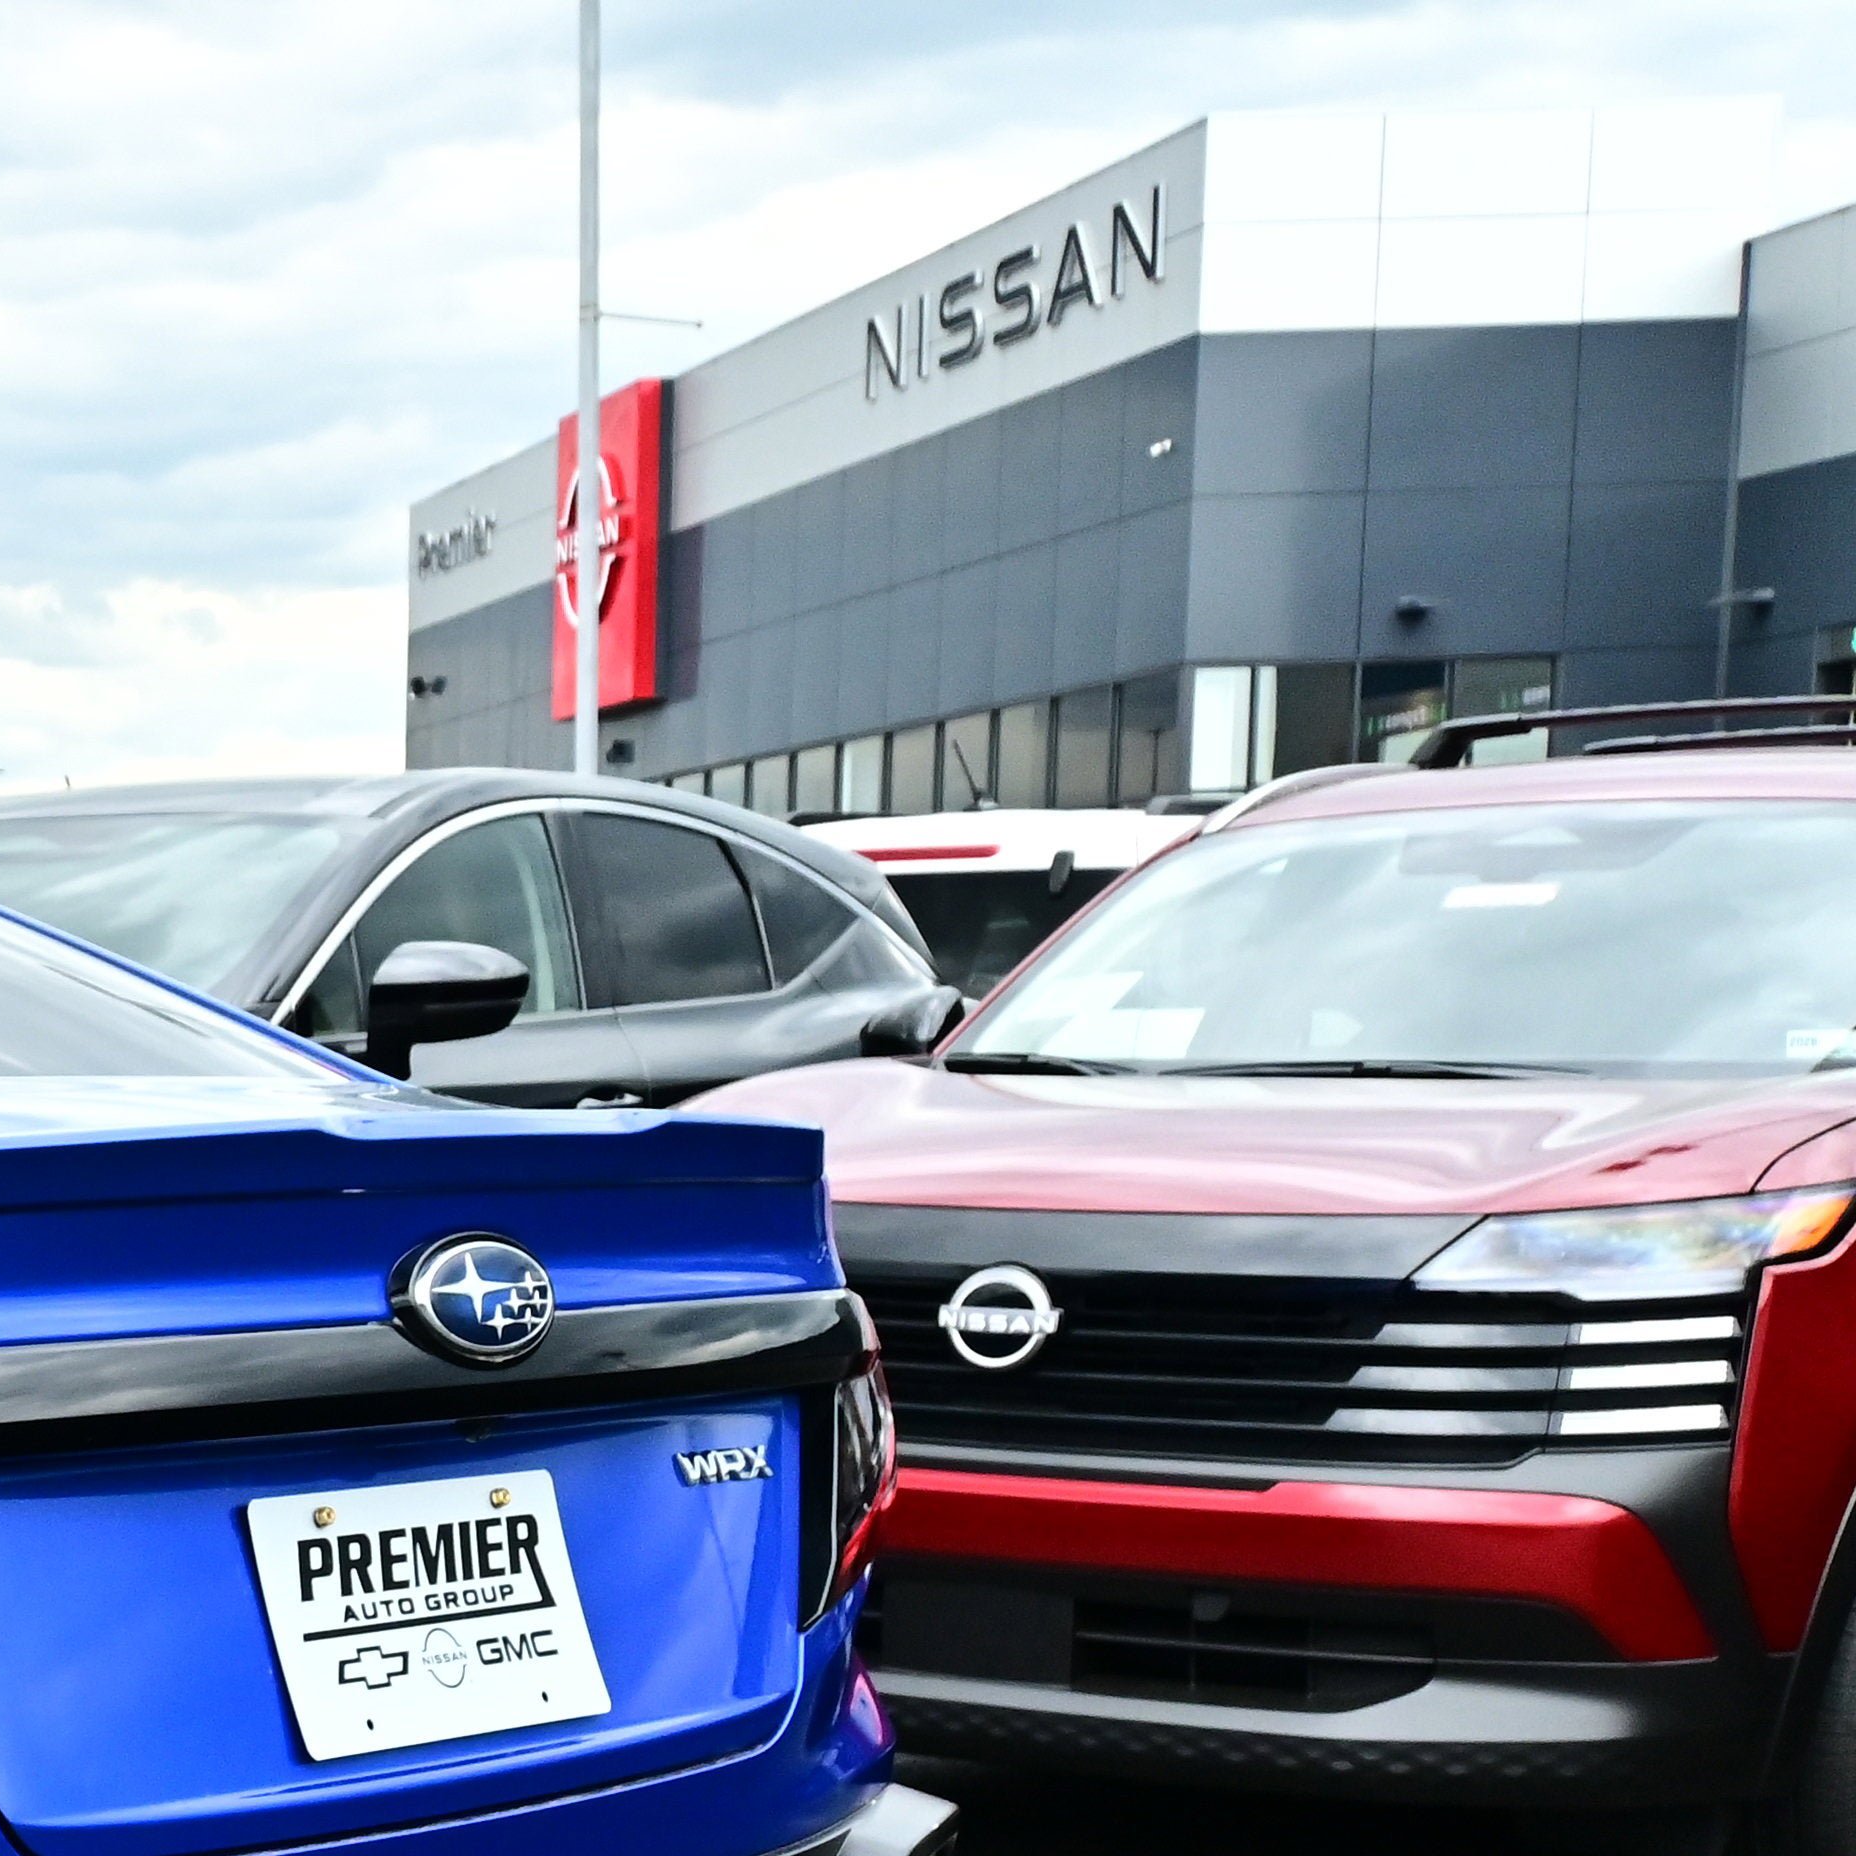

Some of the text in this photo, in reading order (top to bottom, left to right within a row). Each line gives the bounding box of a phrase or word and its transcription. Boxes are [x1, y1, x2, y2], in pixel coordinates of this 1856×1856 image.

[865, 180, 1166, 401] NISSAN
[938, 1307, 1059, 1334] NISSAN
[673, 1445, 774, 1484] WRX
[297, 1514, 557, 1607] PREMIER
[343, 1584, 515, 1623] AUTO GROUP
[422, 1629, 559, 1666] NISSAN GMC
